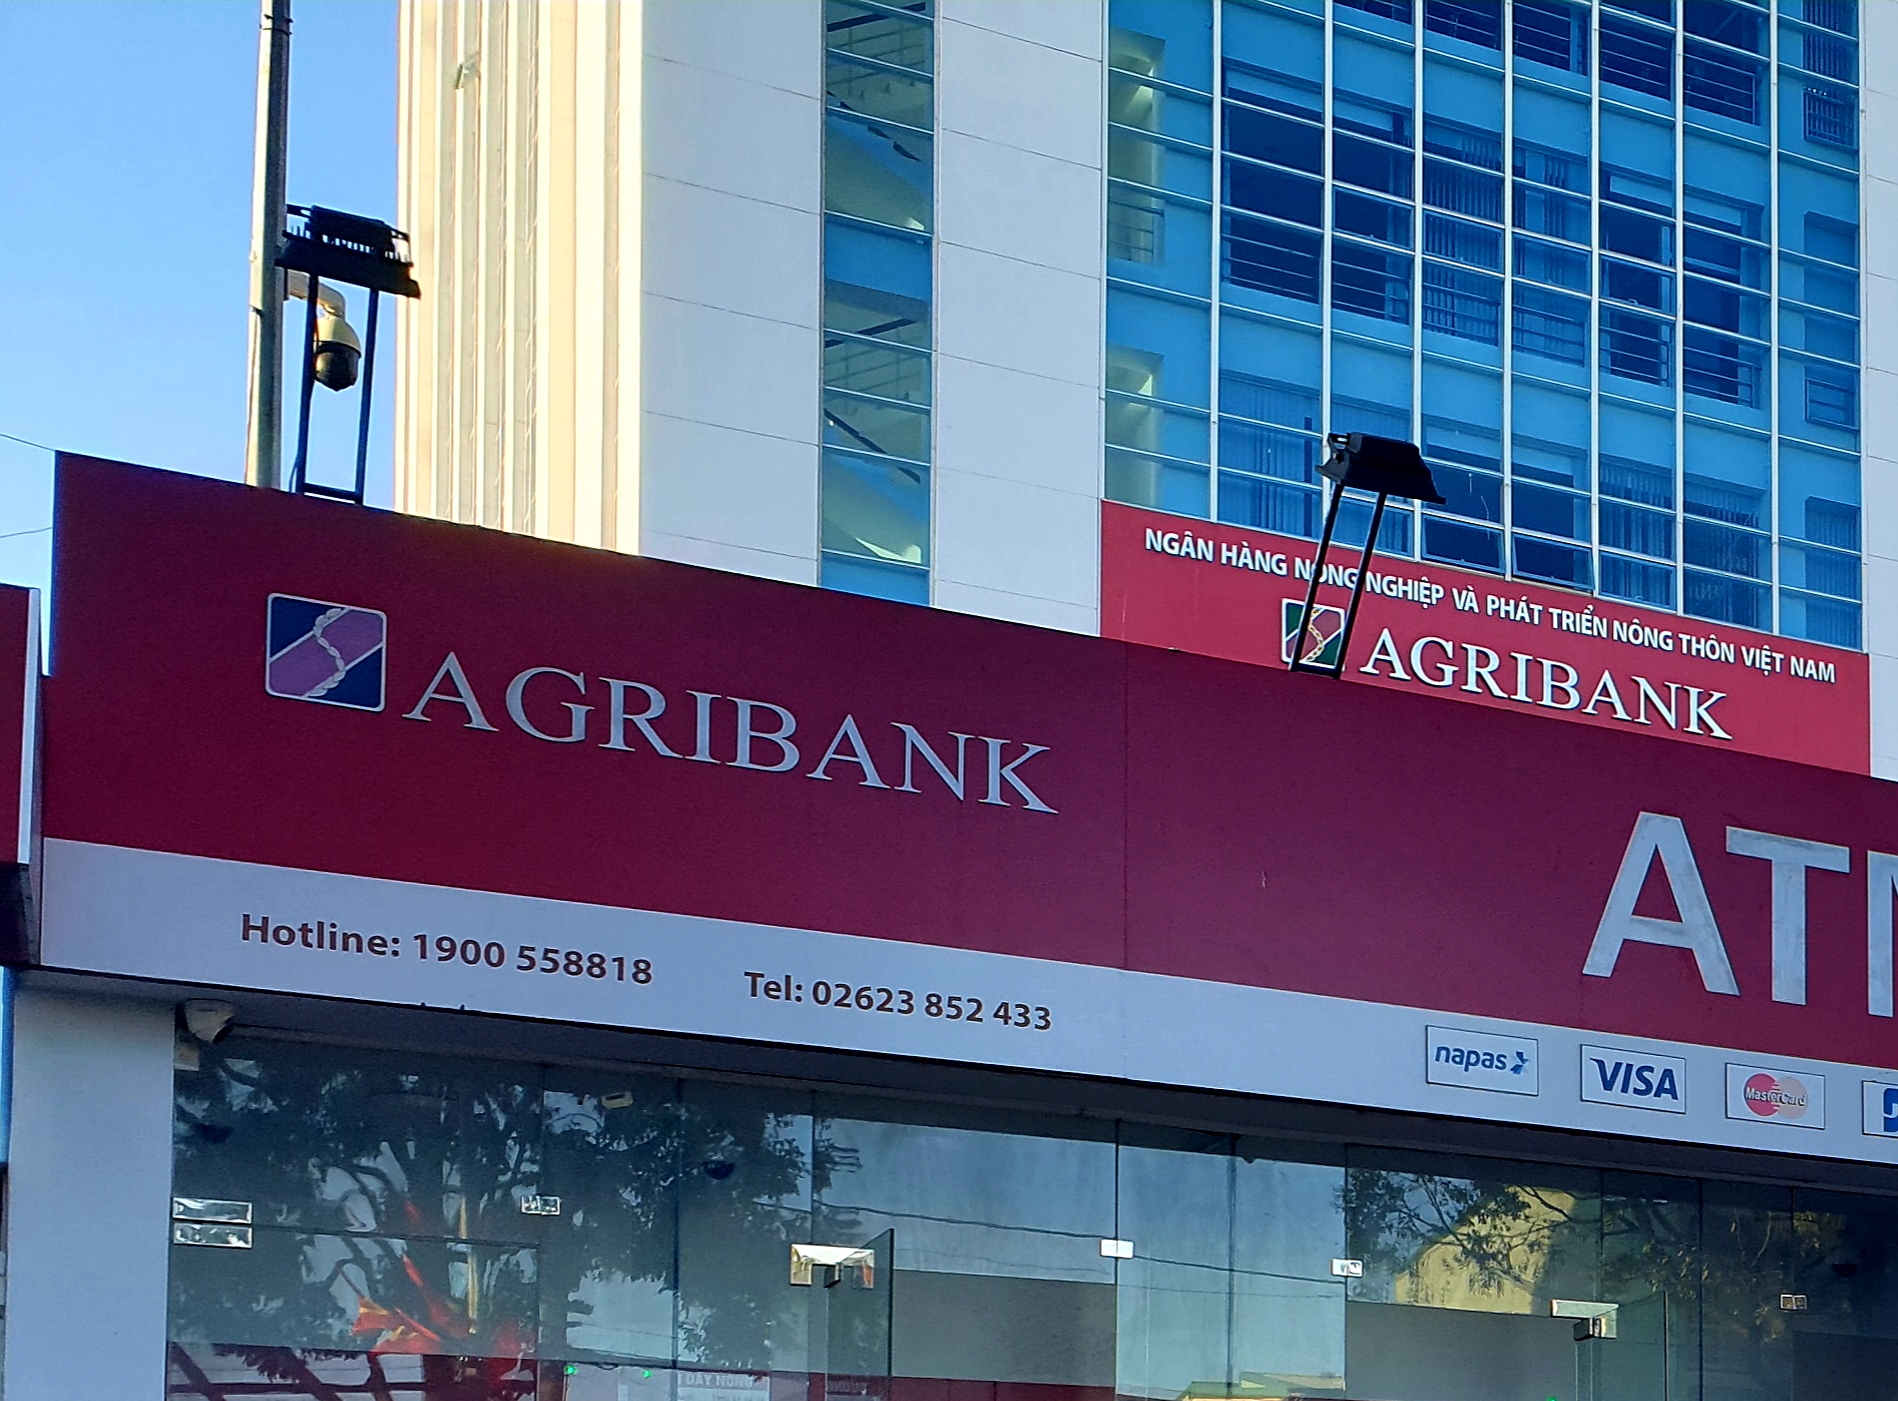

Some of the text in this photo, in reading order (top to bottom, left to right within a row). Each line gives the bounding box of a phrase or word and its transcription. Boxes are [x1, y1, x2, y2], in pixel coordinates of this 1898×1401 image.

[1145, 527, 1213, 562] NGÂN
[1221, 541, 1288, 577] HÀNG
[1366, 571, 1444, 609] NGHIỆP
[1452, 586, 1479, 613] VÀ
[1487, 594, 1542, 625] PHÁT
[1549, 604, 1608, 638] TRIỂN
[1612, 619, 1674, 651] NÔNG
[1679, 632, 1735, 664] THÔN
[1741, 644, 1784, 676] VIỆT
[1790, 656, 1836, 684] NAM
[1360, 632, 1733, 740] AGRIBANK
[403, 652, 1058, 814] AGRIBANK
[242, 913, 652, 984] Hotline: 1900 558818
[744, 971, 1051, 1031] Tel: 02623 852 433
[1435, 1045, 1508, 1073] napas
[1589, 1057, 1679, 1101] VISA
[1745, 1086, 1807, 1107] MasterCard
